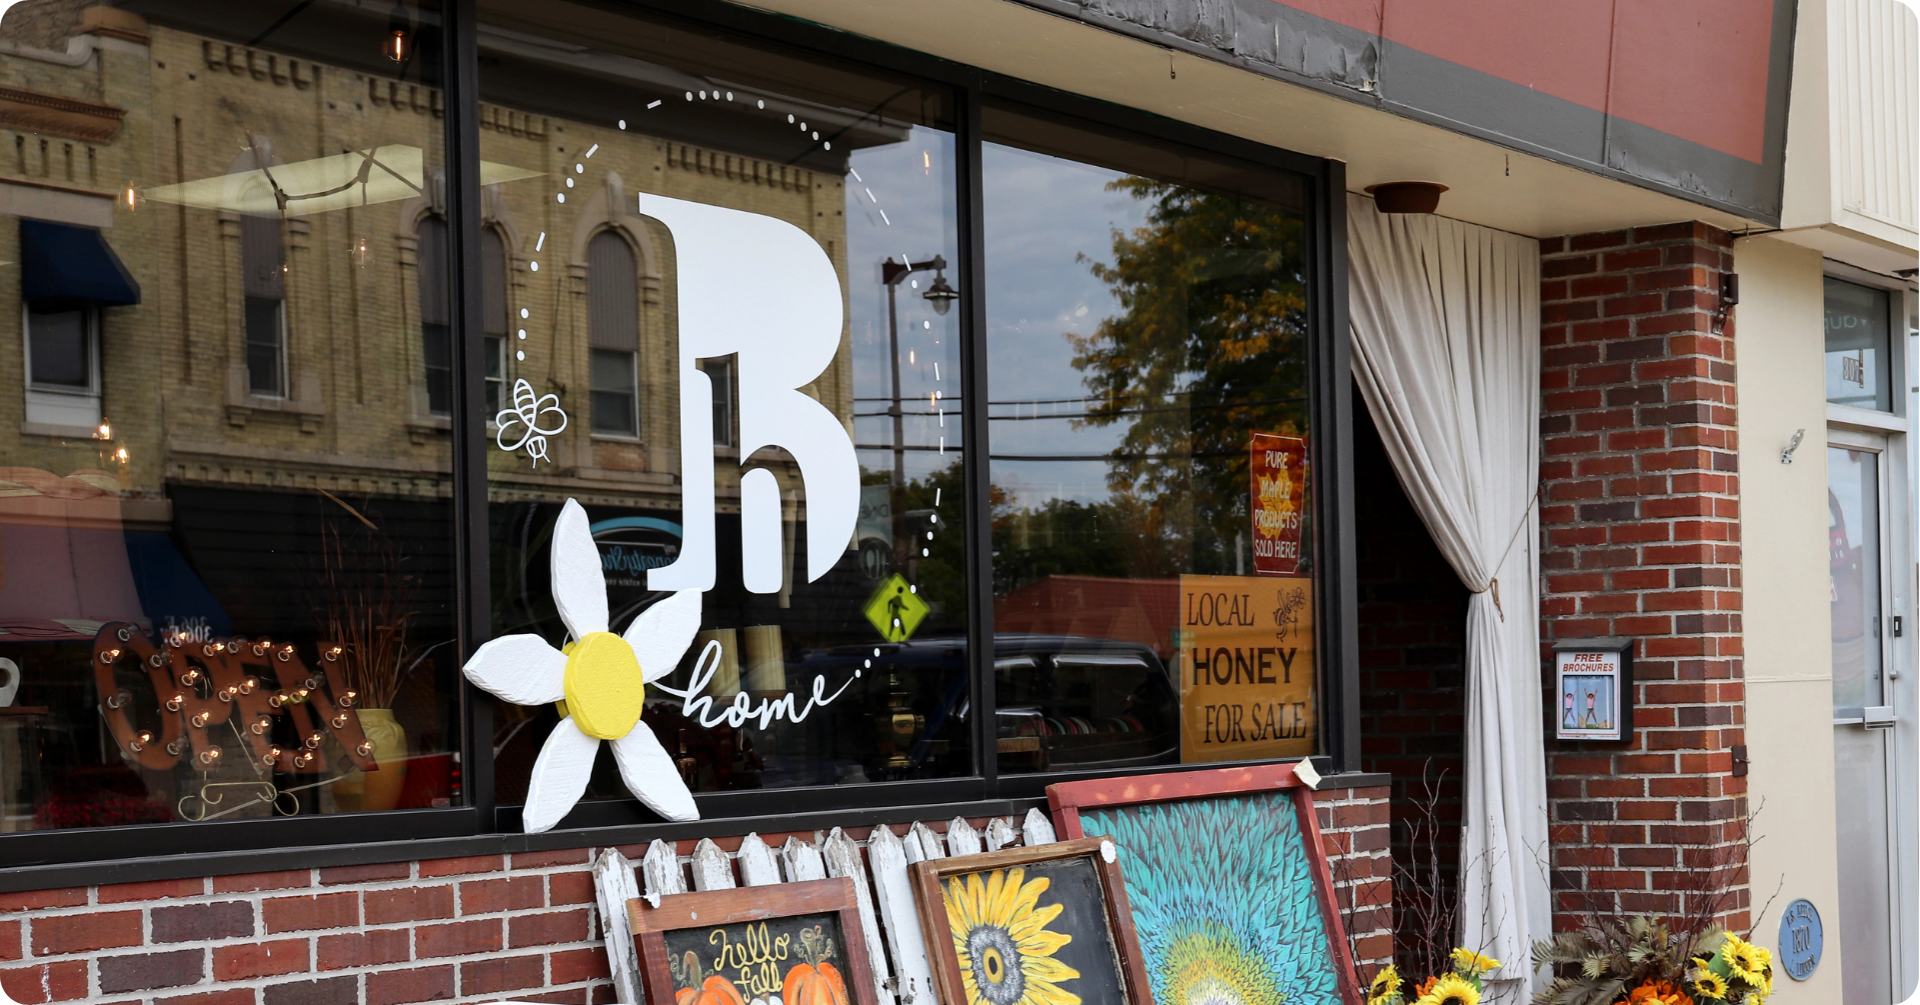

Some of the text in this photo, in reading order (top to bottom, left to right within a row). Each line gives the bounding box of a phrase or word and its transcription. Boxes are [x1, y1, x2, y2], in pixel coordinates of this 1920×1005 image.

[1265, 450, 1289, 470] PURE
[1261, 480, 1291, 500] MAPLE
[1254, 508, 1297, 530] PRODUCTS
[1254, 539, 1297, 559] SOLD HERE
[1187, 592, 1255, 627] LOCAL
[1192, 647, 1298, 686] HONEY
[1563, 663, 1614, 672] BROCHURES
[1574, 653, 1604, 663] FREE
[94, 621, 380, 773] OPEN
[650, 639, 855, 730] home
[1203, 701, 1307, 744] FOR SALE
[709, 921, 790, 971] hello
[1791, 925, 1810, 954] 1870
[734, 962, 784, 1004] fall
